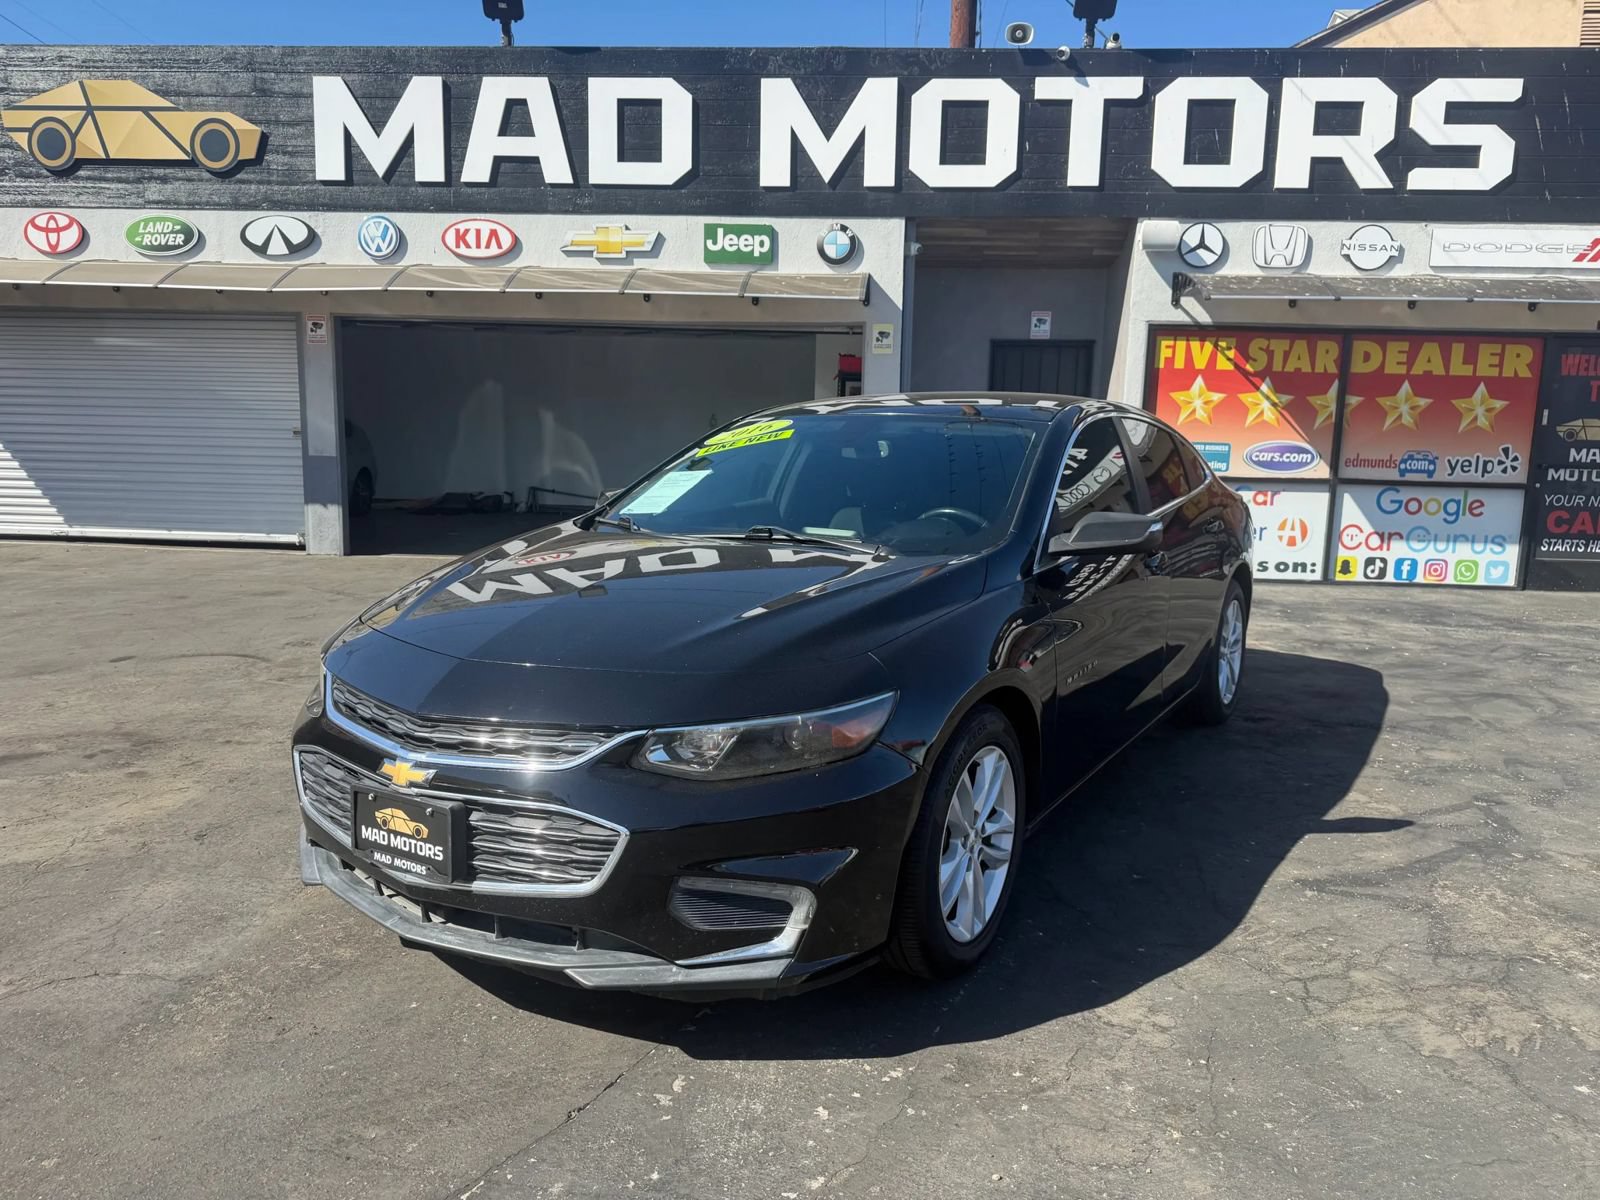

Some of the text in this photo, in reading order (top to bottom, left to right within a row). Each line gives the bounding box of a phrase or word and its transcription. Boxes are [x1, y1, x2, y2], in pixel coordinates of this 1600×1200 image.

[312, 75, 1525, 191] MAD MOTORS
[138, 222, 172, 233] LAND
[454, 228, 503, 249] KIA
[142, 234, 184, 245] ROVER
[706, 228, 770, 257] Jeep
[1342, 242, 1398, 252] NISSAN
[1443, 243, 1592, 254] DODGE
[1155, 336, 1534, 378] FIVE STAR DEALER
[1561, 354, 1600, 377] WEL
[702, 432, 784, 454] LIKE NEW
[1208, 460, 1228, 471] ting
[1251, 452, 1313, 464] cars.com
[1344, 453, 1398, 470] edmunds
[1446, 455, 1495, 478] yelp
[1376, 486, 1486, 525] Google
[1544, 494, 1600, 507] YOUR N
[1546, 510, 1600, 535] CA
[1339, 524, 1508, 555] CarGurus
[1540, 538, 1586, 553] STARTS
[361, 825, 444, 861] MAD MOTORS
[373, 851, 427, 875] MAD MOTORS
